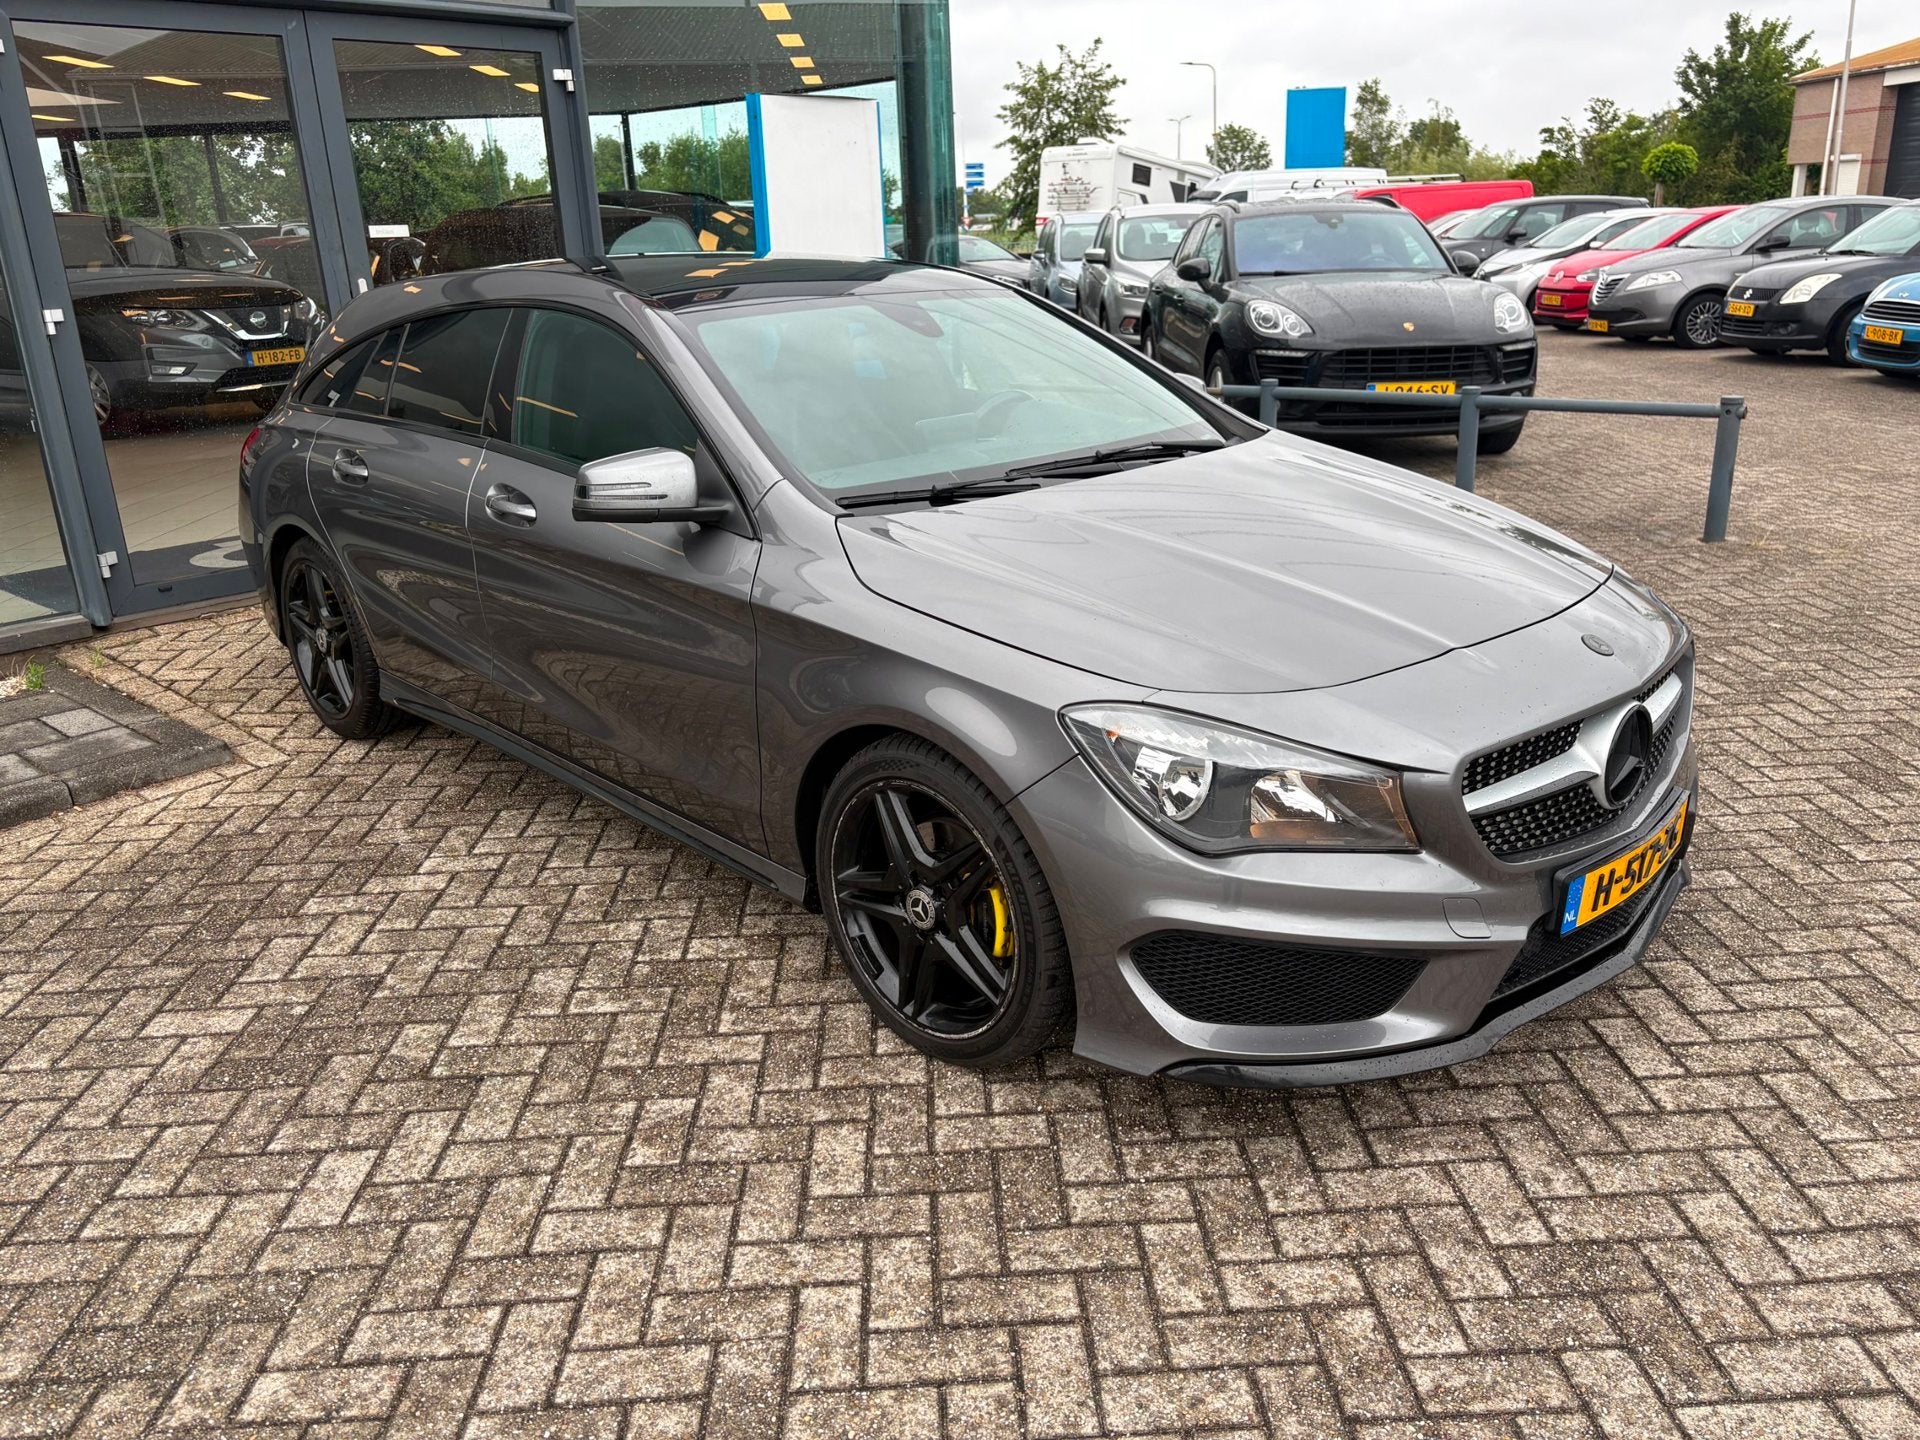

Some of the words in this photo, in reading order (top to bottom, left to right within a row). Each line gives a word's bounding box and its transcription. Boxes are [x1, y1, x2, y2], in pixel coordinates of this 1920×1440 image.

[1866, 326, 1900, 343] L-908-BK
[256, 349, 301, 364] H-182-FB
[1564, 909, 1577, 924] NL
